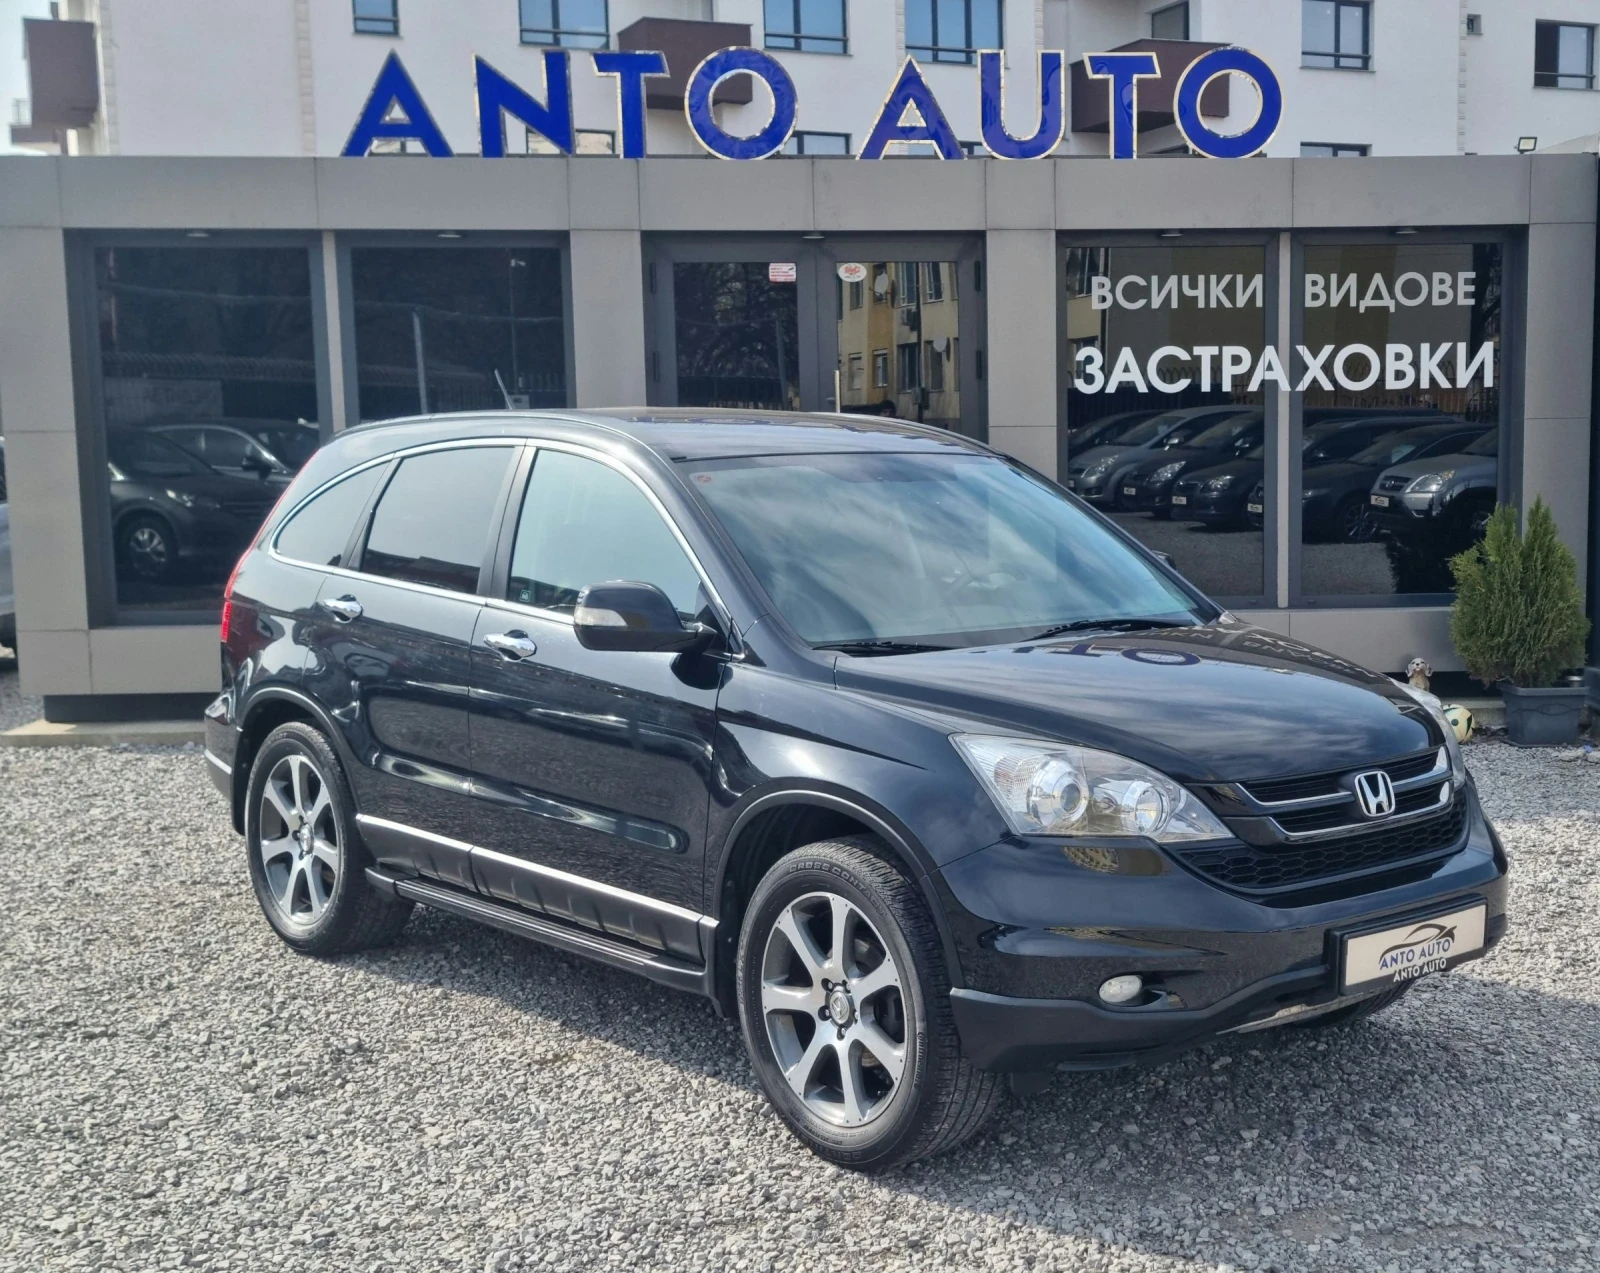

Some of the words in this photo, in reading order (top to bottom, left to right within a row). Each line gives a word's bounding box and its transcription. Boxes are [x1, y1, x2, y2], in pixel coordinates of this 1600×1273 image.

[341, 45, 798, 160] ANTO
[855, 45, 1283, 160] AUTO
[1091, 273, 1263, 310] ВСИЧКИ
[1304, 270, 1476, 314] ВИДОВЕ
[1074, 340, 1495, 395] ЗАСТРАХОВКИ
[789, 861, 830, 873] CROSS
[831, 866, 888, 917] CONTACT
[1380, 949, 1415, 969] ANTO
[1420, 940, 1451, 958] AUTO
[1393, 967, 1420, 982] ANTO
[1423, 959, 1447, 973] AUTO
